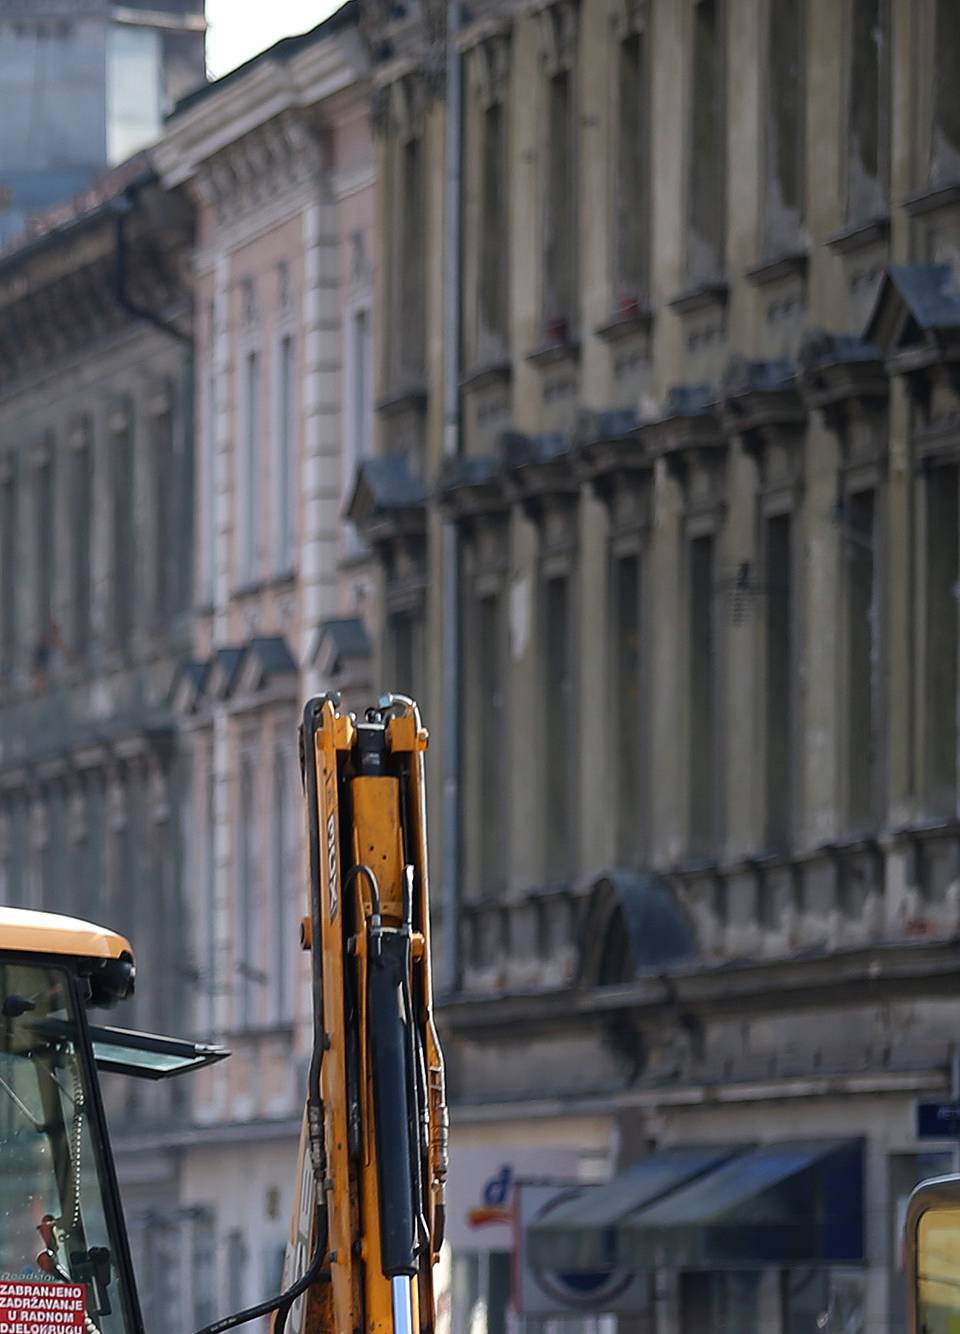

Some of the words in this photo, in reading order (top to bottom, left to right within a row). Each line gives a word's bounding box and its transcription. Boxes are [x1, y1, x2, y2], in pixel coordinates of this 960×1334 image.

[0, 1285, 82, 1298] ZABRANJENO
[7, 1310, 17, 1321] U
[21, 1311, 74, 1323] RADNOM
